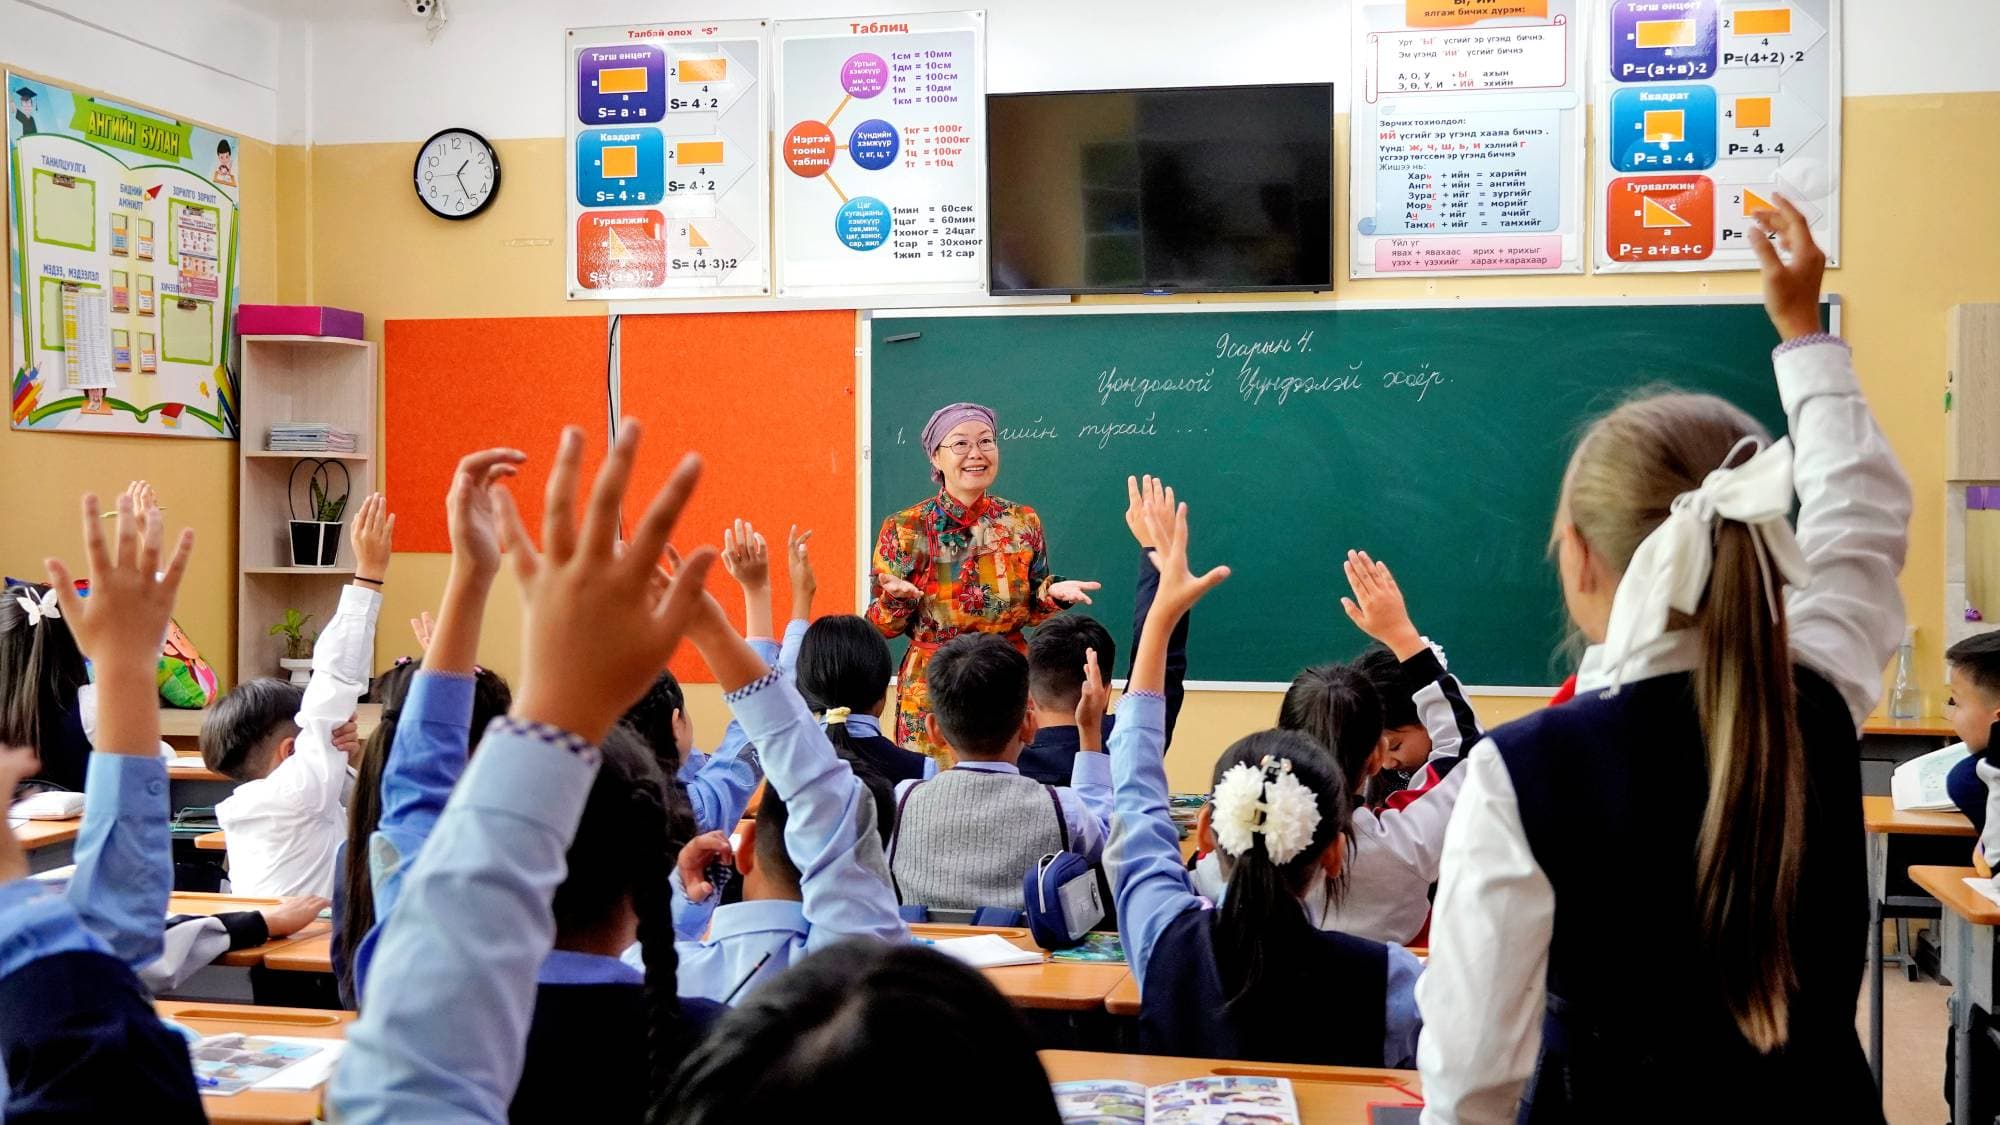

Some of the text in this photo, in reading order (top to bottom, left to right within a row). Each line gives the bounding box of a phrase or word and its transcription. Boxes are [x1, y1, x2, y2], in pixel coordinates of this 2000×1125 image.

[1491, 7, 1526, 16] дүрэм:
[850, 23, 908, 34] Таблиц
[628, 30, 665, 38] Талбай
[668, 29, 692, 37] олох
[1761, 38, 1769, 46] 4
[670, 68, 676, 76] 2
[893, 64, 912, 72] 1дм
[926, 84, 952, 93] 10дм
[1640, 92, 1689, 102] Квадрат
[1414, 118, 1466, 126] тохиолдол:
[89, 111, 181, 156] АНГИЙН БУЛАН
[600, 133, 640, 142] Квадрат
[857, 132, 892, 140] Хүндийн
[1380, 131, 1396, 140] ИЙ
[1400, 131, 1431, 140] үсгийг
[1449, 131, 1477, 139] үгэнд
[1752, 129, 1760, 137] 4
[451, 137, 461, 149] 12
[793, 136, 831, 145] Нэртэй
[934, 136, 970, 144] 1000кг
[438, 143, 446, 156] 11
[469, 141, 473, 153] 1
[793, 147, 826, 155] тооны
[428, 156, 439, 168] 10
[478, 152, 486, 164] 2
[793, 157, 831, 167] таблиц
[41, 154, 86, 174] ТАНИЛЦУУЛГА
[935, 159, 954, 167] 10ц
[425, 171, 433, 183] 9
[484, 166, 493, 179] 3
[1489, 170, 1527, 178] харийн
[480, 182, 488, 194] 4
[1490, 180, 1526, 188] ангийн
[1627, 182, 1695, 193] Гурвалжин
[430, 185, 438, 198] 8
[1492, 190, 1532, 198] зургийг
[442, 195, 449, 207] 7
[456, 198, 464, 212] 6
[470, 194, 479, 207] 5
[1407, 202, 1432, 210] Морь
[1491, 200, 1528, 208] морийг
[593, 217, 648, 226] Гурвалжин
[893, 240, 918, 248] 1сар
[955, 250, 975, 258] сар
[1079, 411, 1157, 449] тухай
